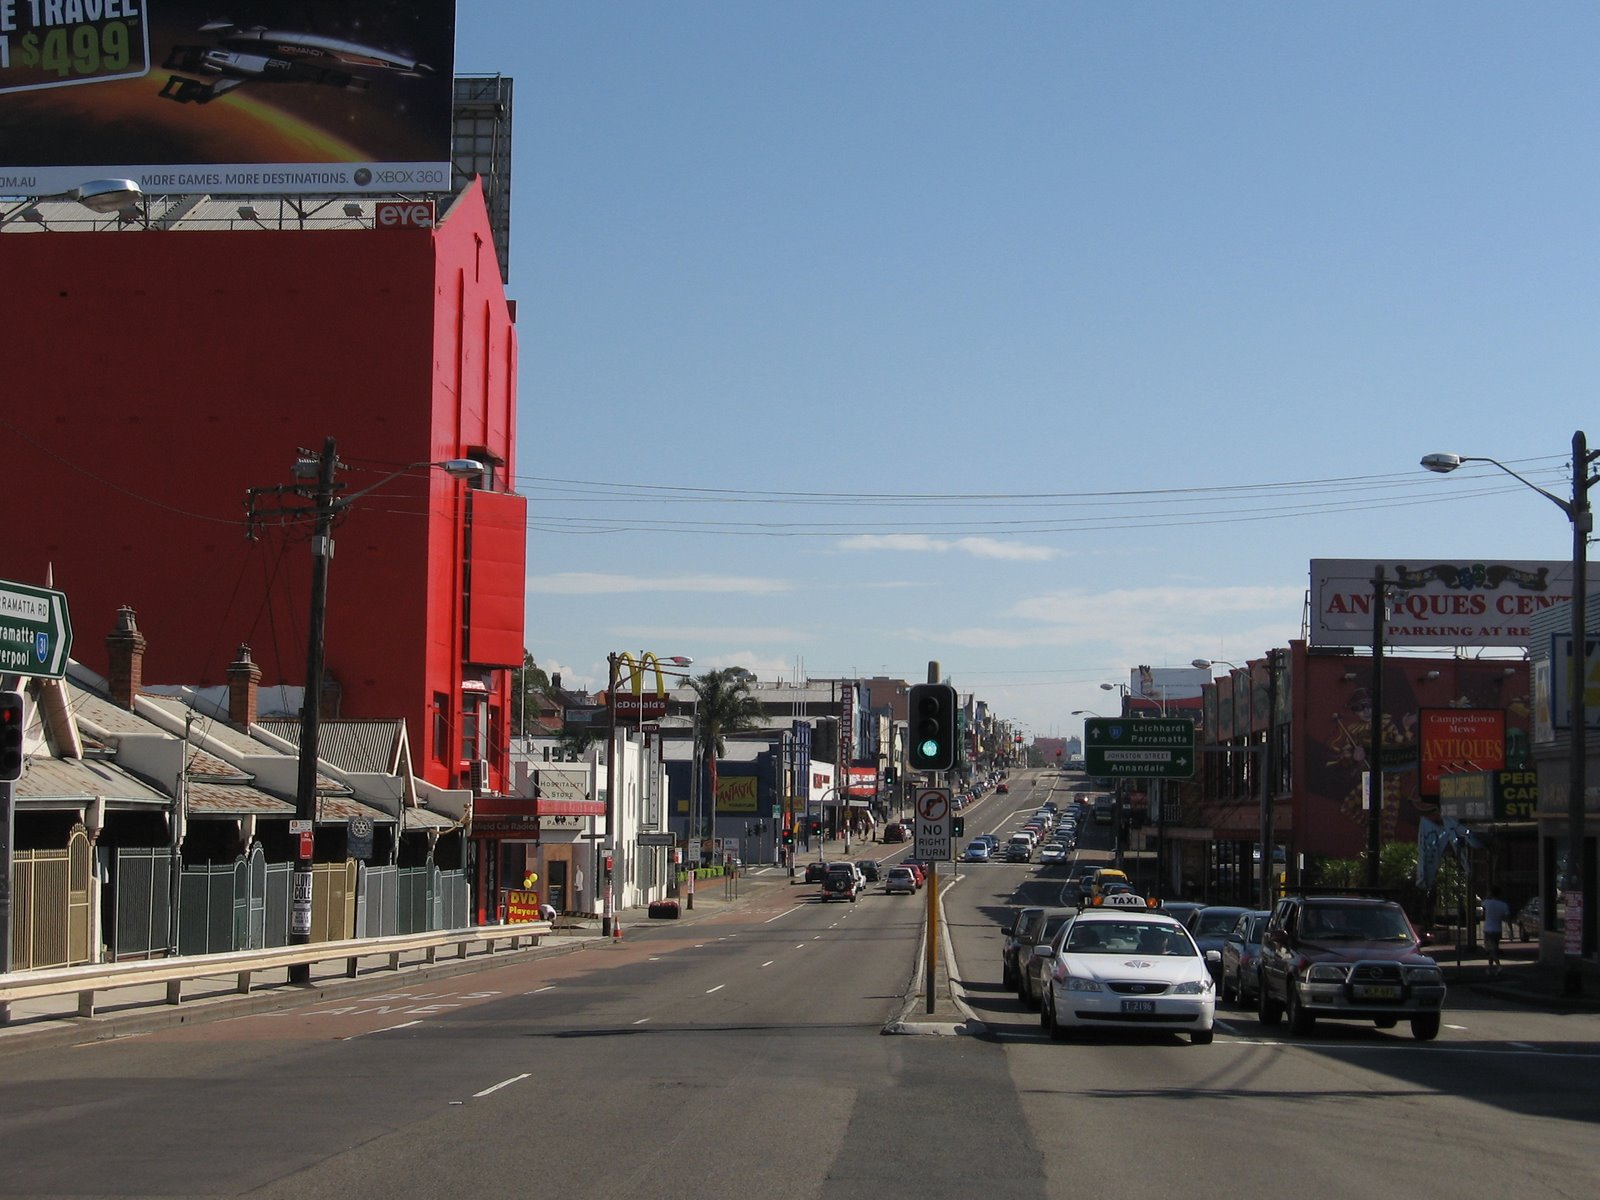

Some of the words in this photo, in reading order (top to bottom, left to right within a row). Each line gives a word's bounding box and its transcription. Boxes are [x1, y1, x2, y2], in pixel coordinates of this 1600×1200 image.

[28, 0, 138, 27] TRAVEL
[21, 21, 130, 77] $499
[141, 175, 176, 186] MORE
[178, 174, 223, 185] GAMES.
[225, 173, 259, 184] MORE
[262, 172, 349, 184] DESTINATIONS.
[375, 170, 414, 183] XBOX
[416, 170, 443, 182] 360
[379, 205, 433, 227] eye
[0, 595, 35, 615] RAMATTA
[38, 603, 48, 616] RD
[1326, 593, 1486, 620] ANIQUES
[1496, 594, 1573, 615] CEN
[1388, 626, 1473, 636] PARKING
[1478, 627, 1502, 636] AT
[39, 637, 47, 654] 31
[0, 648, 30, 668] erpool
[608, 700, 666, 709] cDonald's
[1430, 714, 1495, 725] Camperdown
[1132, 724, 1185, 732] Leichhardt
[1449, 725, 1476, 734] Mews
[1131, 735, 1187, 743] Parramatta
[543, 746, 578, 762] 193
[1423, 737, 1503, 761] ANTIQUES
[1111, 763, 1165, 772] Annandale
[923, 824, 942, 835] NO
[919, 838, 946, 846] RIGHT
[920, 848, 946, 856] TURN
[295, 887, 311, 899] COLE
[510, 891, 538, 905] DVD
[1112, 897, 1137, 905] TAXI
[509, 905, 539, 917] Players
